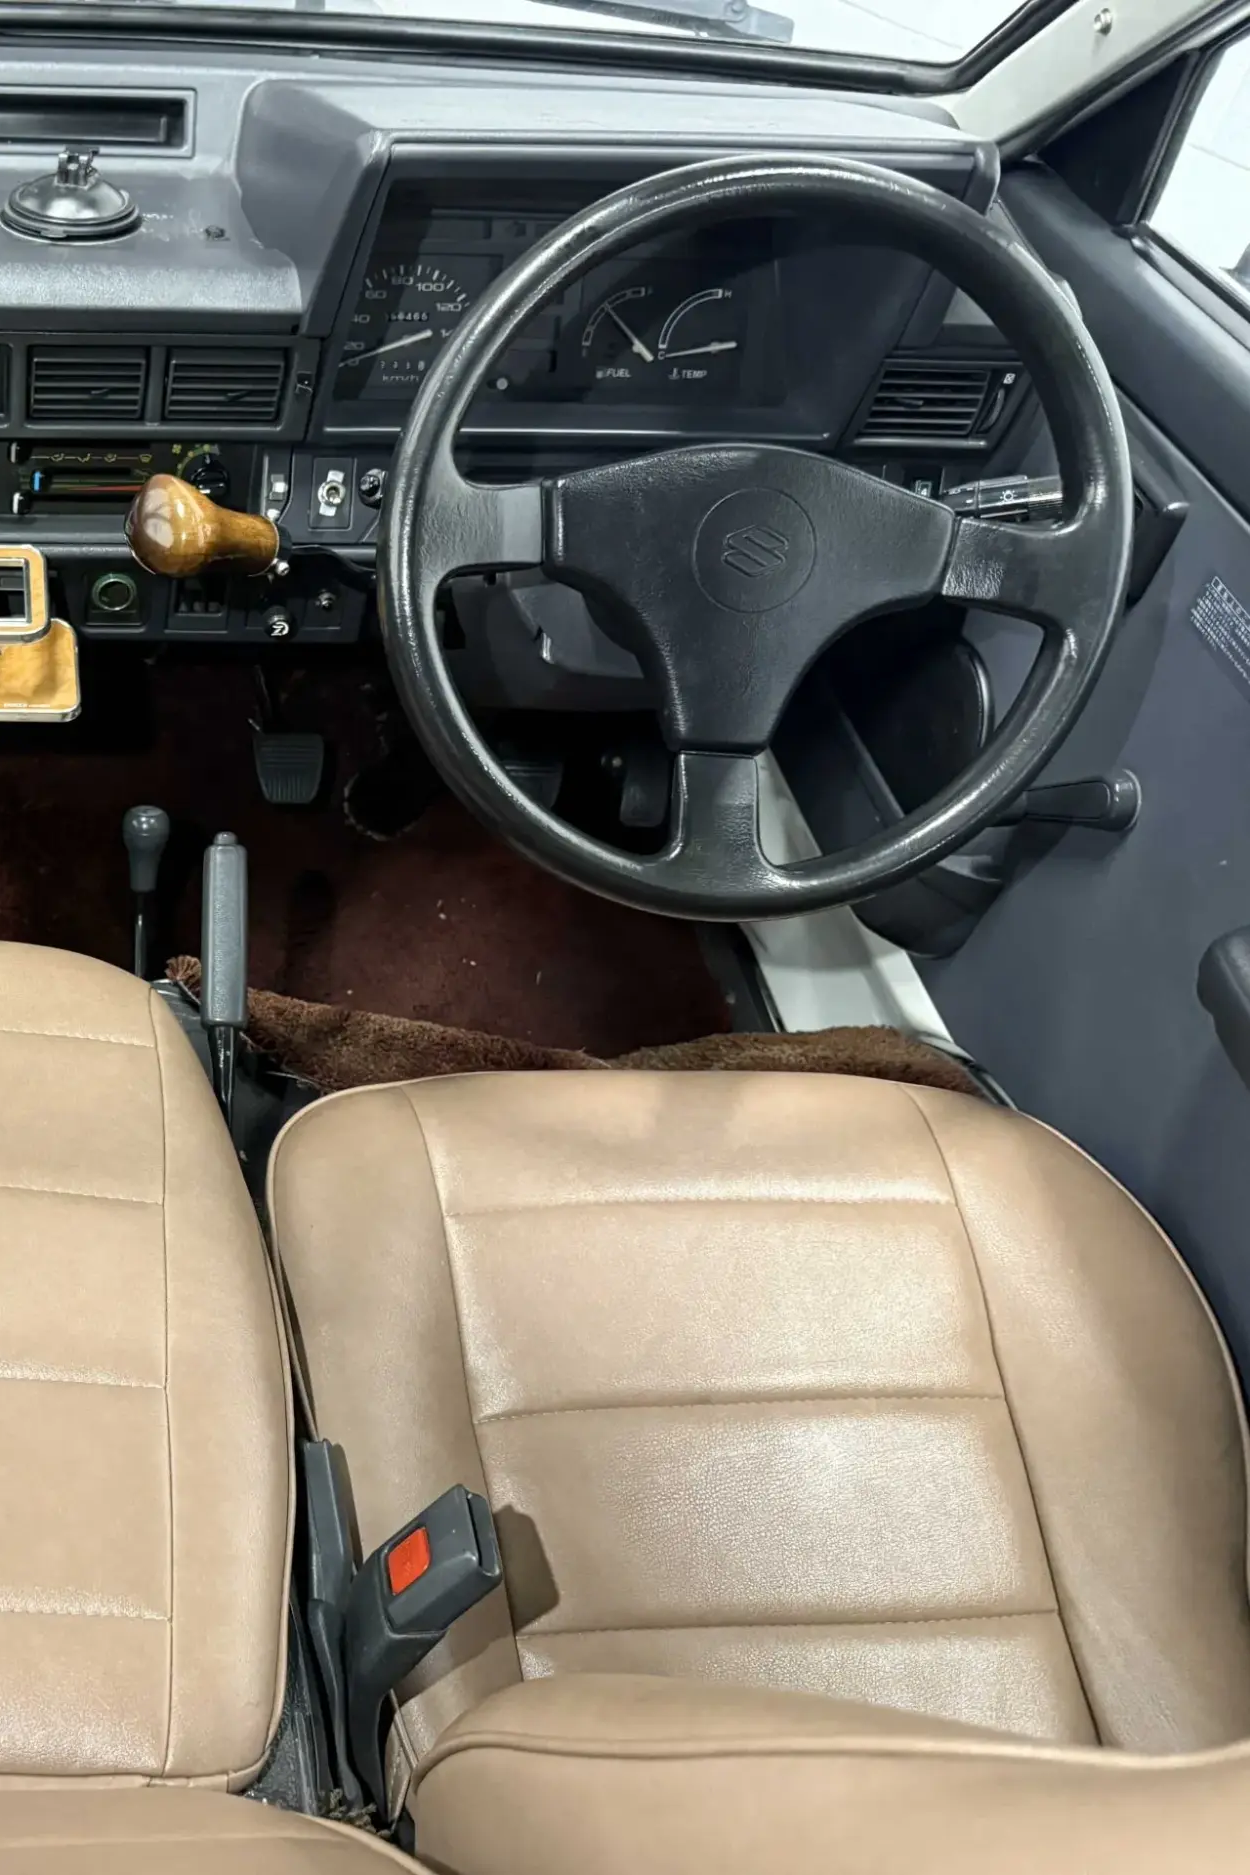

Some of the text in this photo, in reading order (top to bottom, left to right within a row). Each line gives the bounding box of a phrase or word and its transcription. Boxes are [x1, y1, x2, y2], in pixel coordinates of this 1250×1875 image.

[416, 282, 445, 292] 100
[364, 289, 387, 299] 60
[435, 302, 462, 312] 120
[606, 368, 631, 378] FUEL
[681, 369, 707, 379] TEMP
